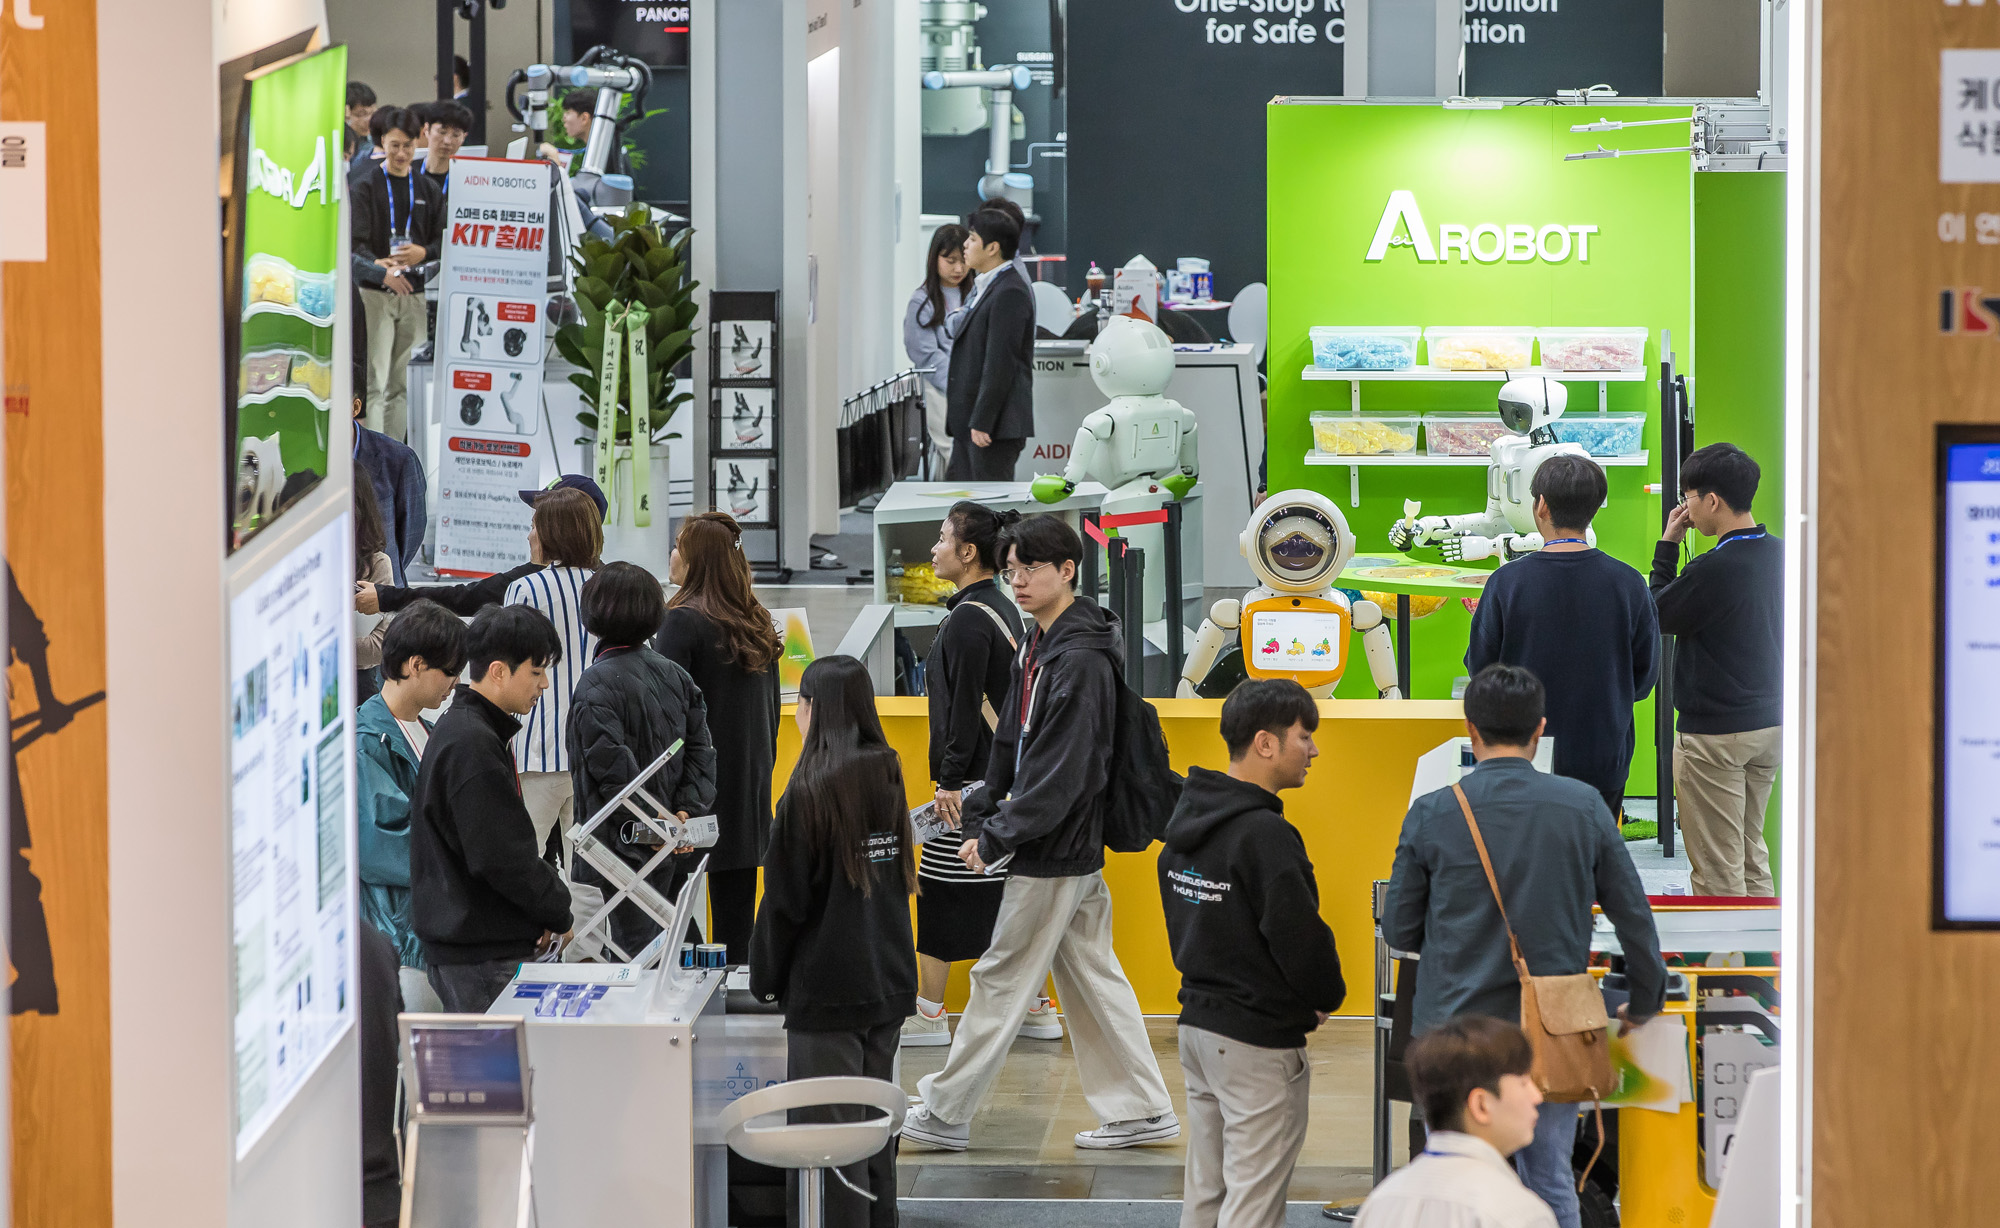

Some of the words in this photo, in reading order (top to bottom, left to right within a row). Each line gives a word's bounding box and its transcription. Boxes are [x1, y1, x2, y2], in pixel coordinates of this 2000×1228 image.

[1205, 17, 1246, 44] for
[1252, 17, 1317, 44] Safe
[464, 176, 489, 187] AIDIN
[491, 177, 537, 190] ROBOTICS
[455, 206, 481, 220] 스마트
[451, 222, 495, 247] KIT
[495, 224, 545, 251] 출시!
[1033, 444, 1071, 459] AIDI
